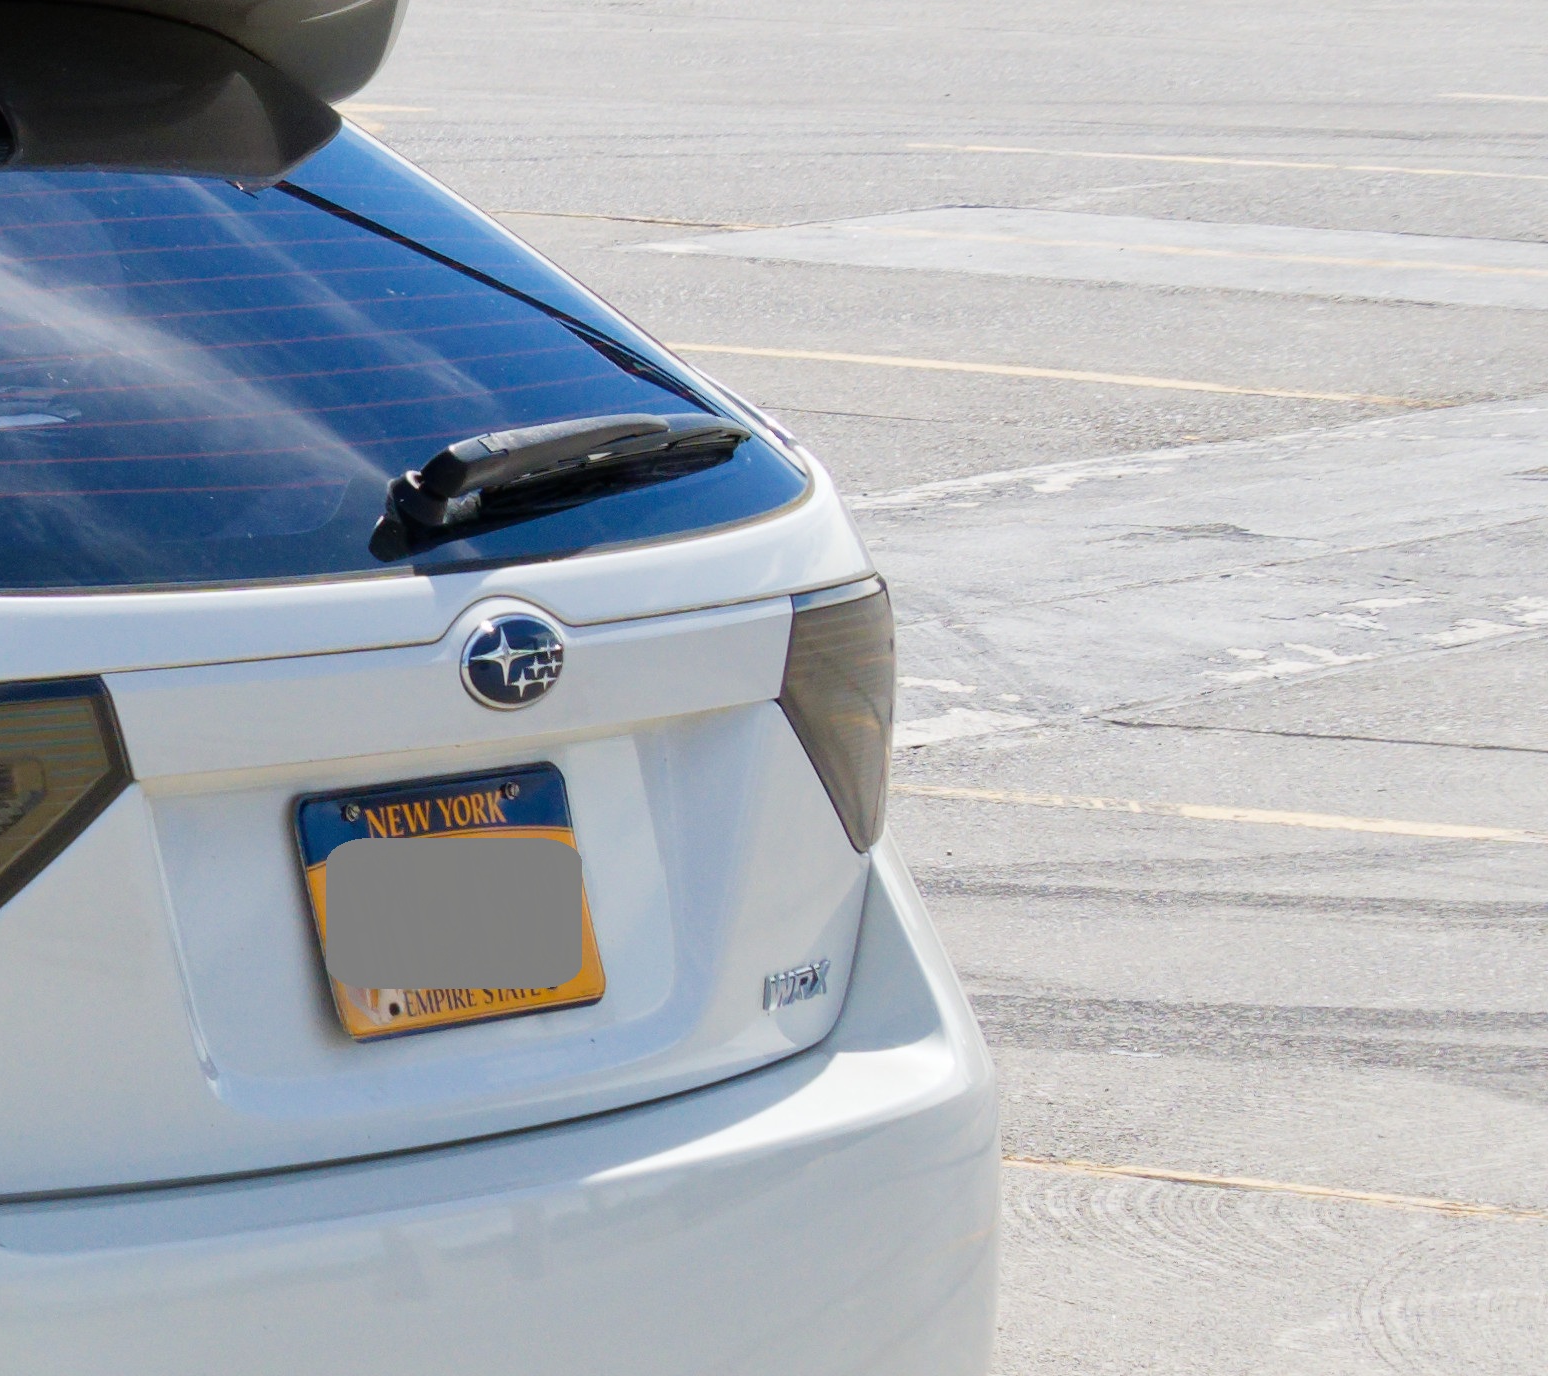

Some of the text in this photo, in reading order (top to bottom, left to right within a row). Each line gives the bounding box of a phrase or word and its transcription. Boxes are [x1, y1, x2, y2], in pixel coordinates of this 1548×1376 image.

[365, 788, 507, 839] NEW YORK
[403, 988, 478, 1018] EMPIRE
[761, 959, 831, 1012] WRX
